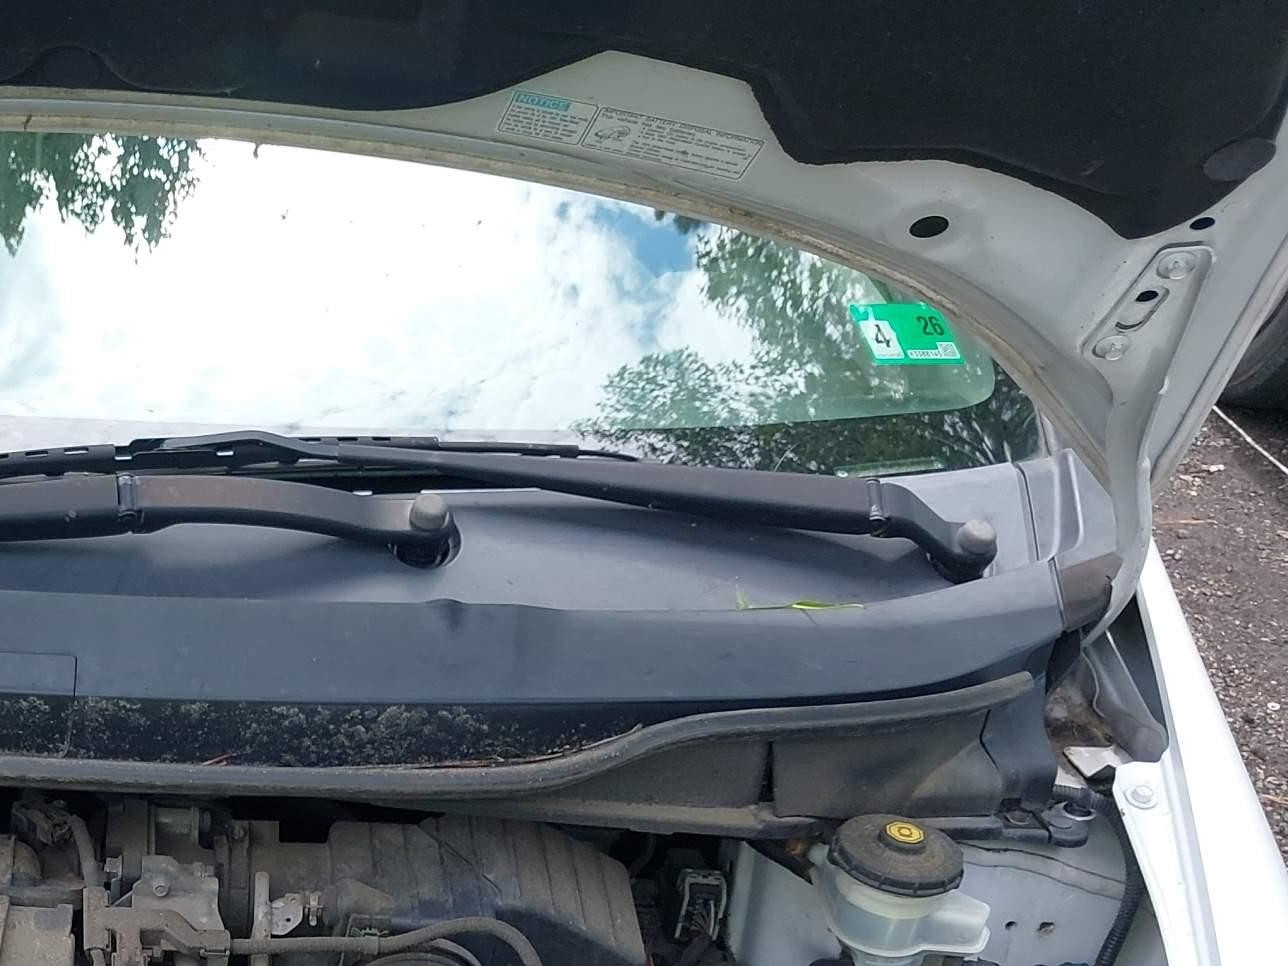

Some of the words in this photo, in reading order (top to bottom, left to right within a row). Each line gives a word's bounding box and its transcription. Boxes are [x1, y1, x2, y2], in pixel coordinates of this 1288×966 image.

[519, 94, 567, 109] NOTICE
[874, 324, 891, 348] 4
[917, 316, 944, 336] 26
